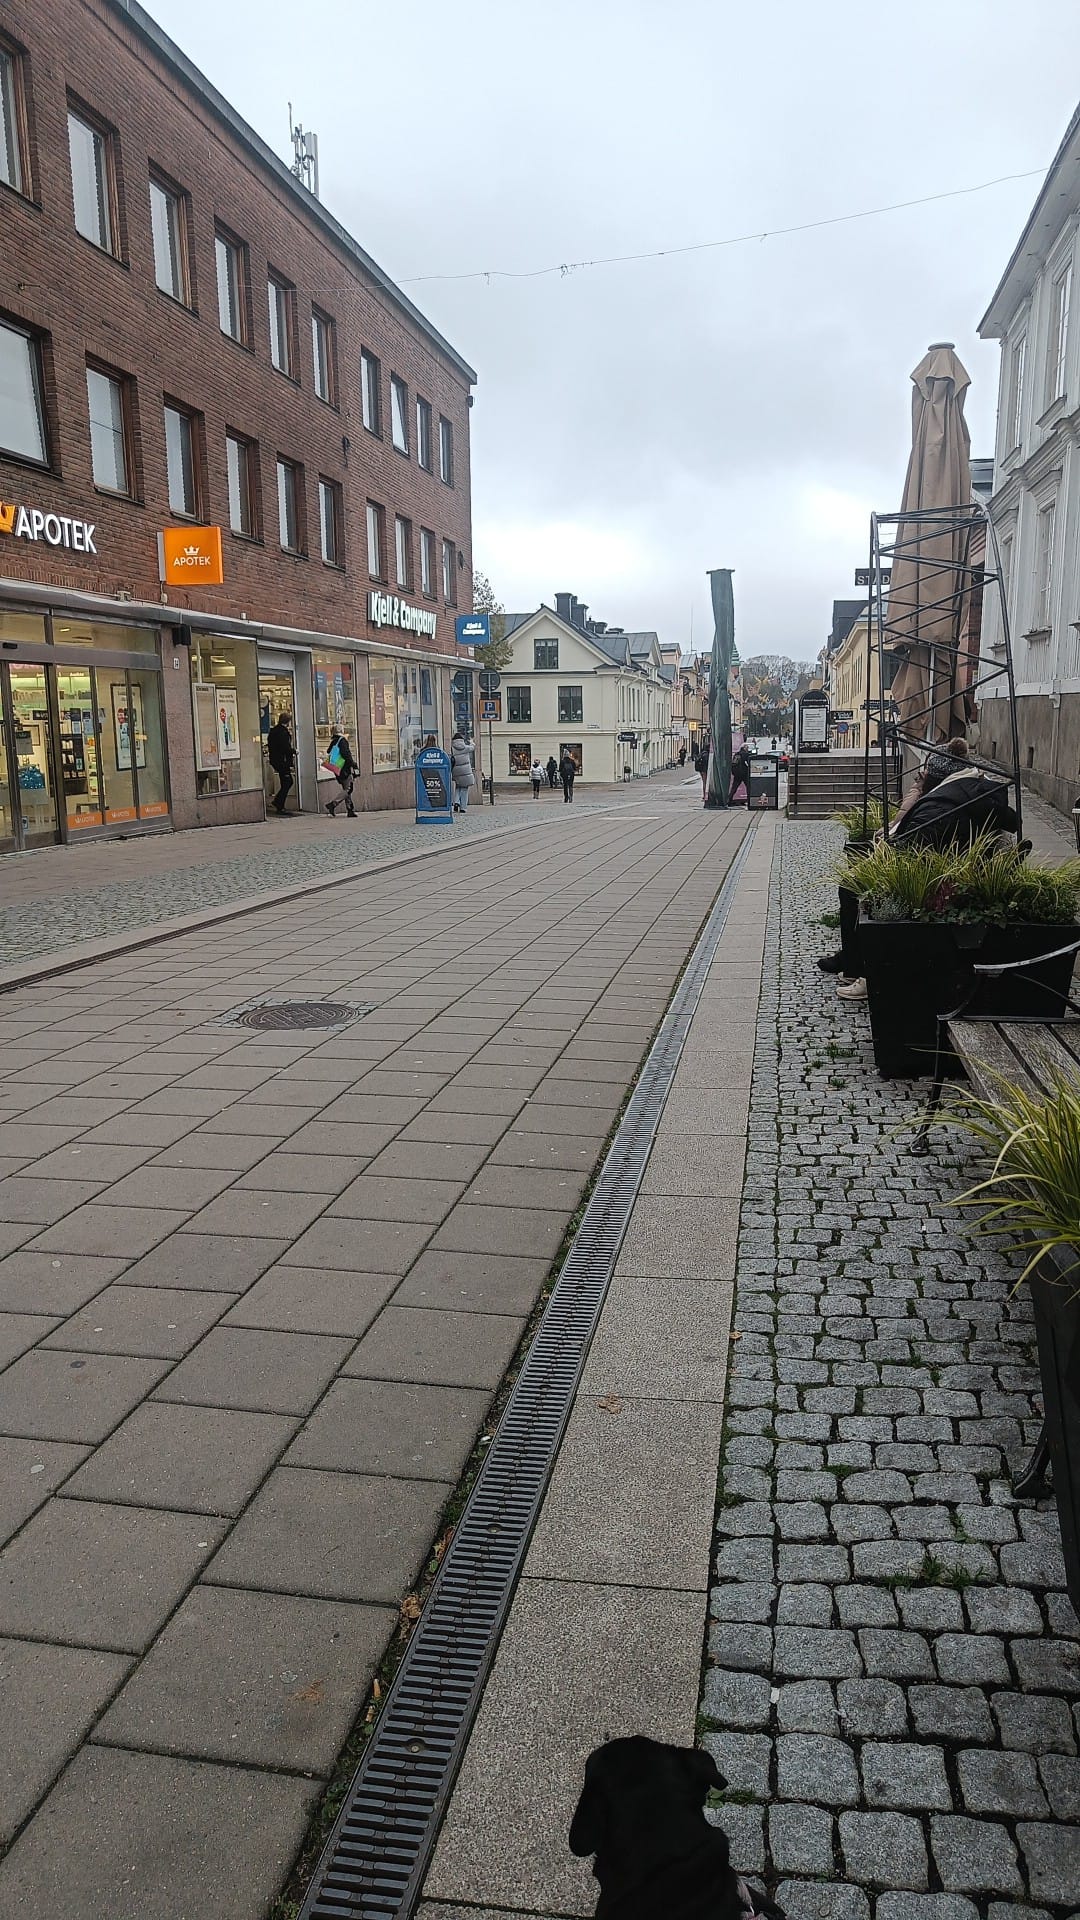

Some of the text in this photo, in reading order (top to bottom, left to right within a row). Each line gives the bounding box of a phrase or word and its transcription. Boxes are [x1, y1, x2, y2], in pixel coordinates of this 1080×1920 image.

[15, 506, 97, 554] APOTEK
[173, 556, 211, 567] APOTEK
[371, 591, 437, 640] Kjell & Company
[487, 702, 493, 711] P
